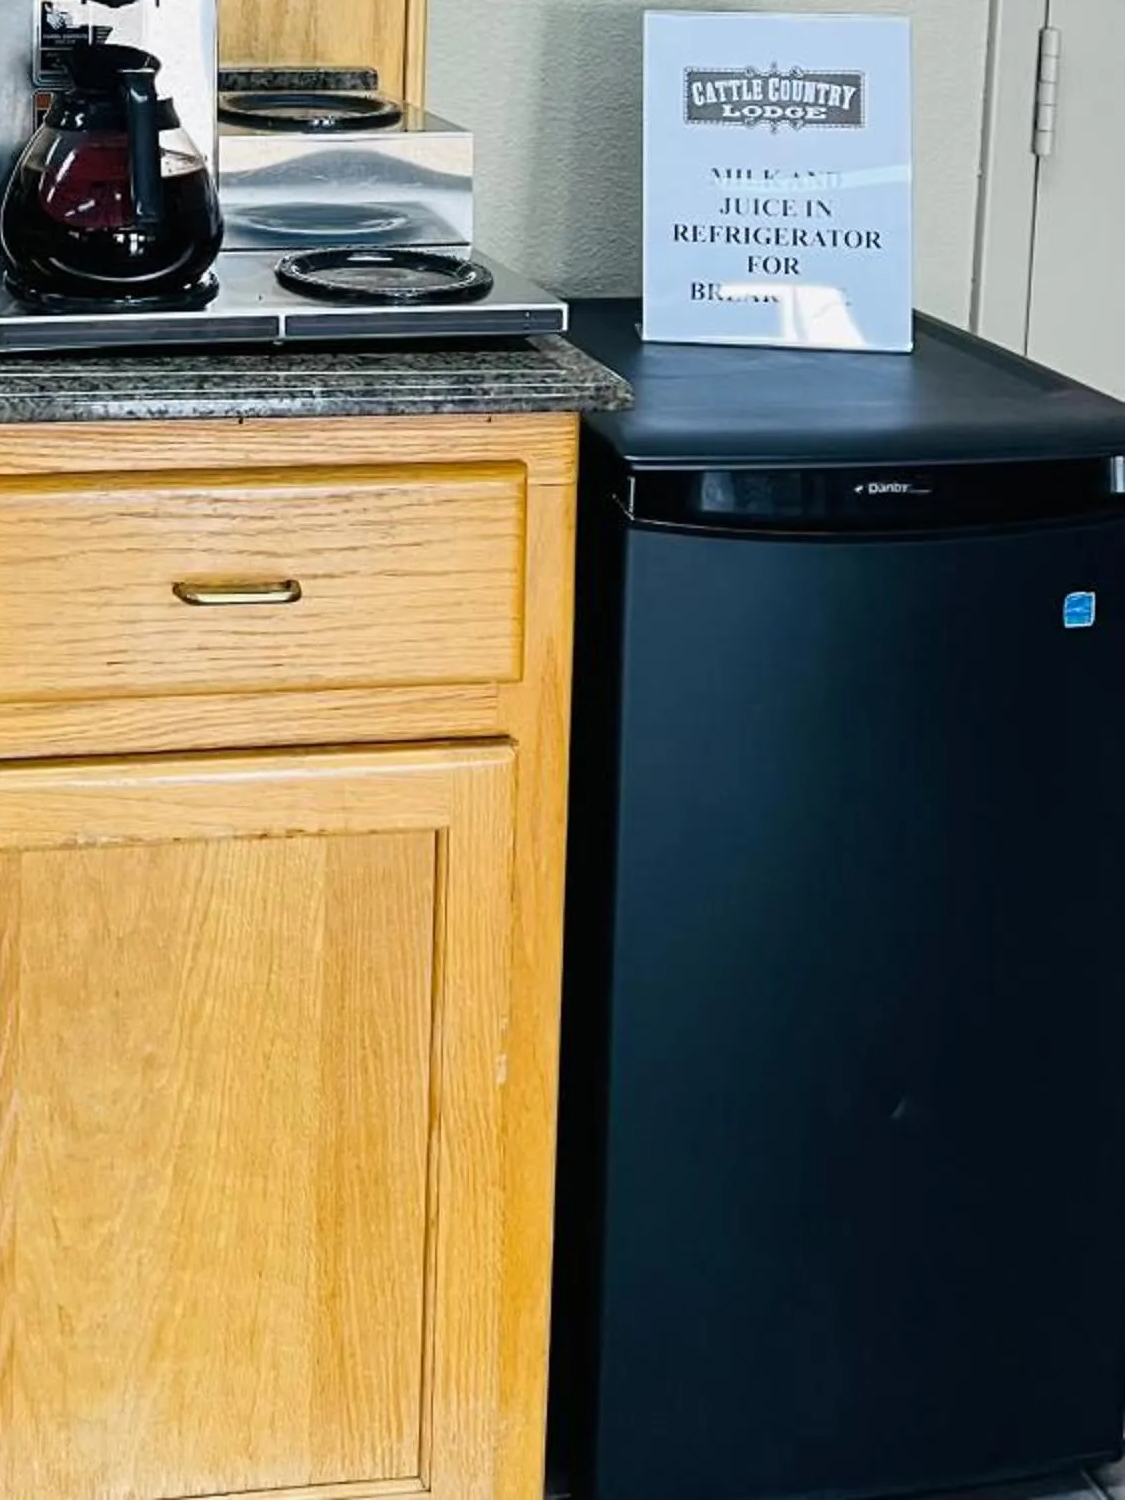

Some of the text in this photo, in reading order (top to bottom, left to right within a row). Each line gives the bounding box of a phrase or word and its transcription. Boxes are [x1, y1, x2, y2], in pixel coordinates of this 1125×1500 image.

[692, 77, 857, 110] CATTLE COUNTRY
[722, 104, 828, 119] LODGE
[719, 197, 832, 218] JUICE IN
[673, 223, 883, 249] REFRIGERATOR
[747, 255, 801, 275] FOR
